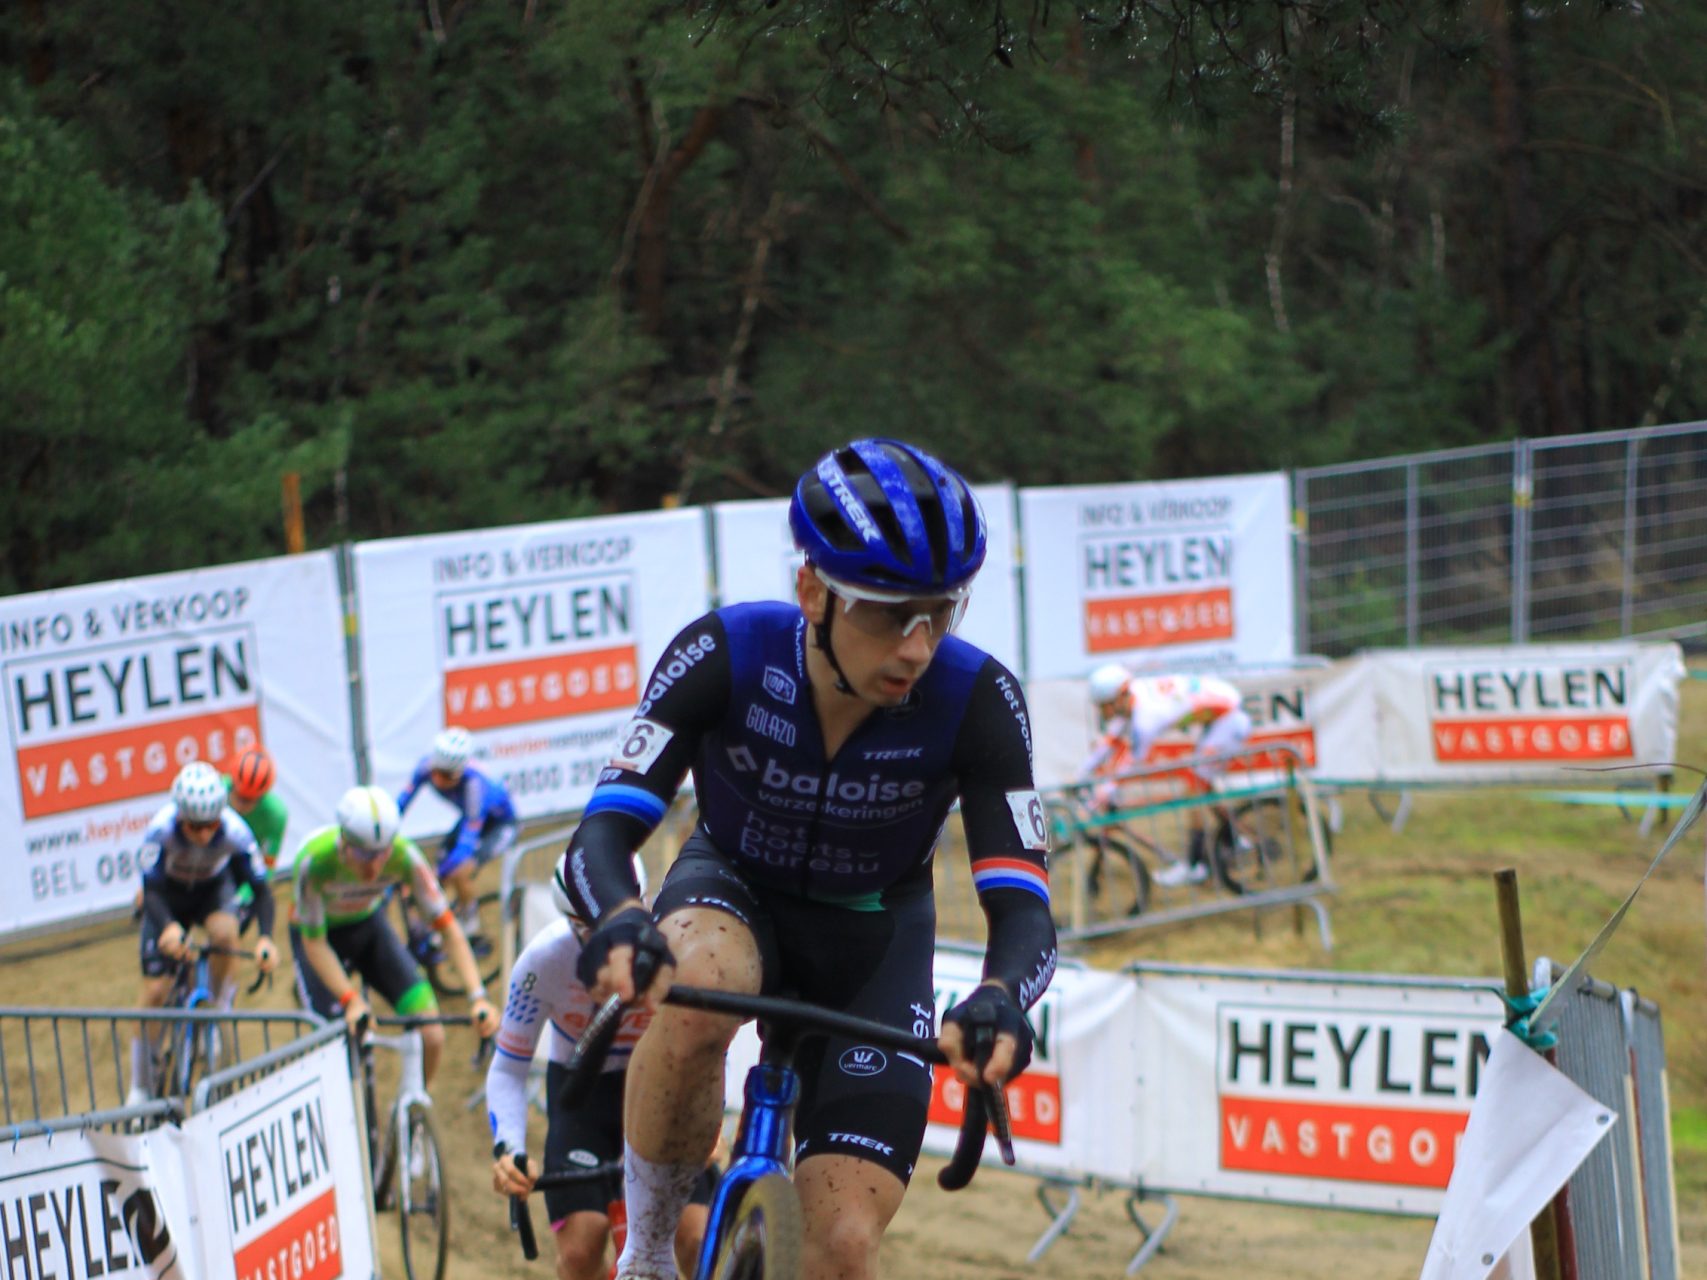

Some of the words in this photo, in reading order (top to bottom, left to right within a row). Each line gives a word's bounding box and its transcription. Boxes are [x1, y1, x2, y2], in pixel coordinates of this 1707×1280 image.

[828, 473, 881, 543] TREK
[434, 553, 493, 583] INFO
[1085, 536, 1232, 588] HEYLEN
[1, 612, 73, 653] INFO
[84, 608, 103, 639] &
[112, 587, 251, 630] VERKOOP
[445, 584, 631, 658] HEYLEN
[15, 638, 250, 734] HEYLEN
[449, 662, 636, 714] VASTGOED
[995, 676, 1019, 710] Het
[1434, 666, 1627, 711] HEYLEN
[622, 723, 655, 759] 6
[746, 703, 796, 747] GOLAZO
[1437, 727, 1629, 755] VASTGOED
[25, 725, 257, 796] VASTGOED
[862, 747, 924, 761] TREK
[762, 758, 925, 802] baloise
[1027, 796, 1046, 844] 6
[31, 858, 88, 901] BEL
[522, 972, 537, 992] 8
[827, 1132, 894, 1156] TREK
[1228, 1116, 1464, 1166] VASTGO
[225, 1096, 330, 1234] HEYLEN
